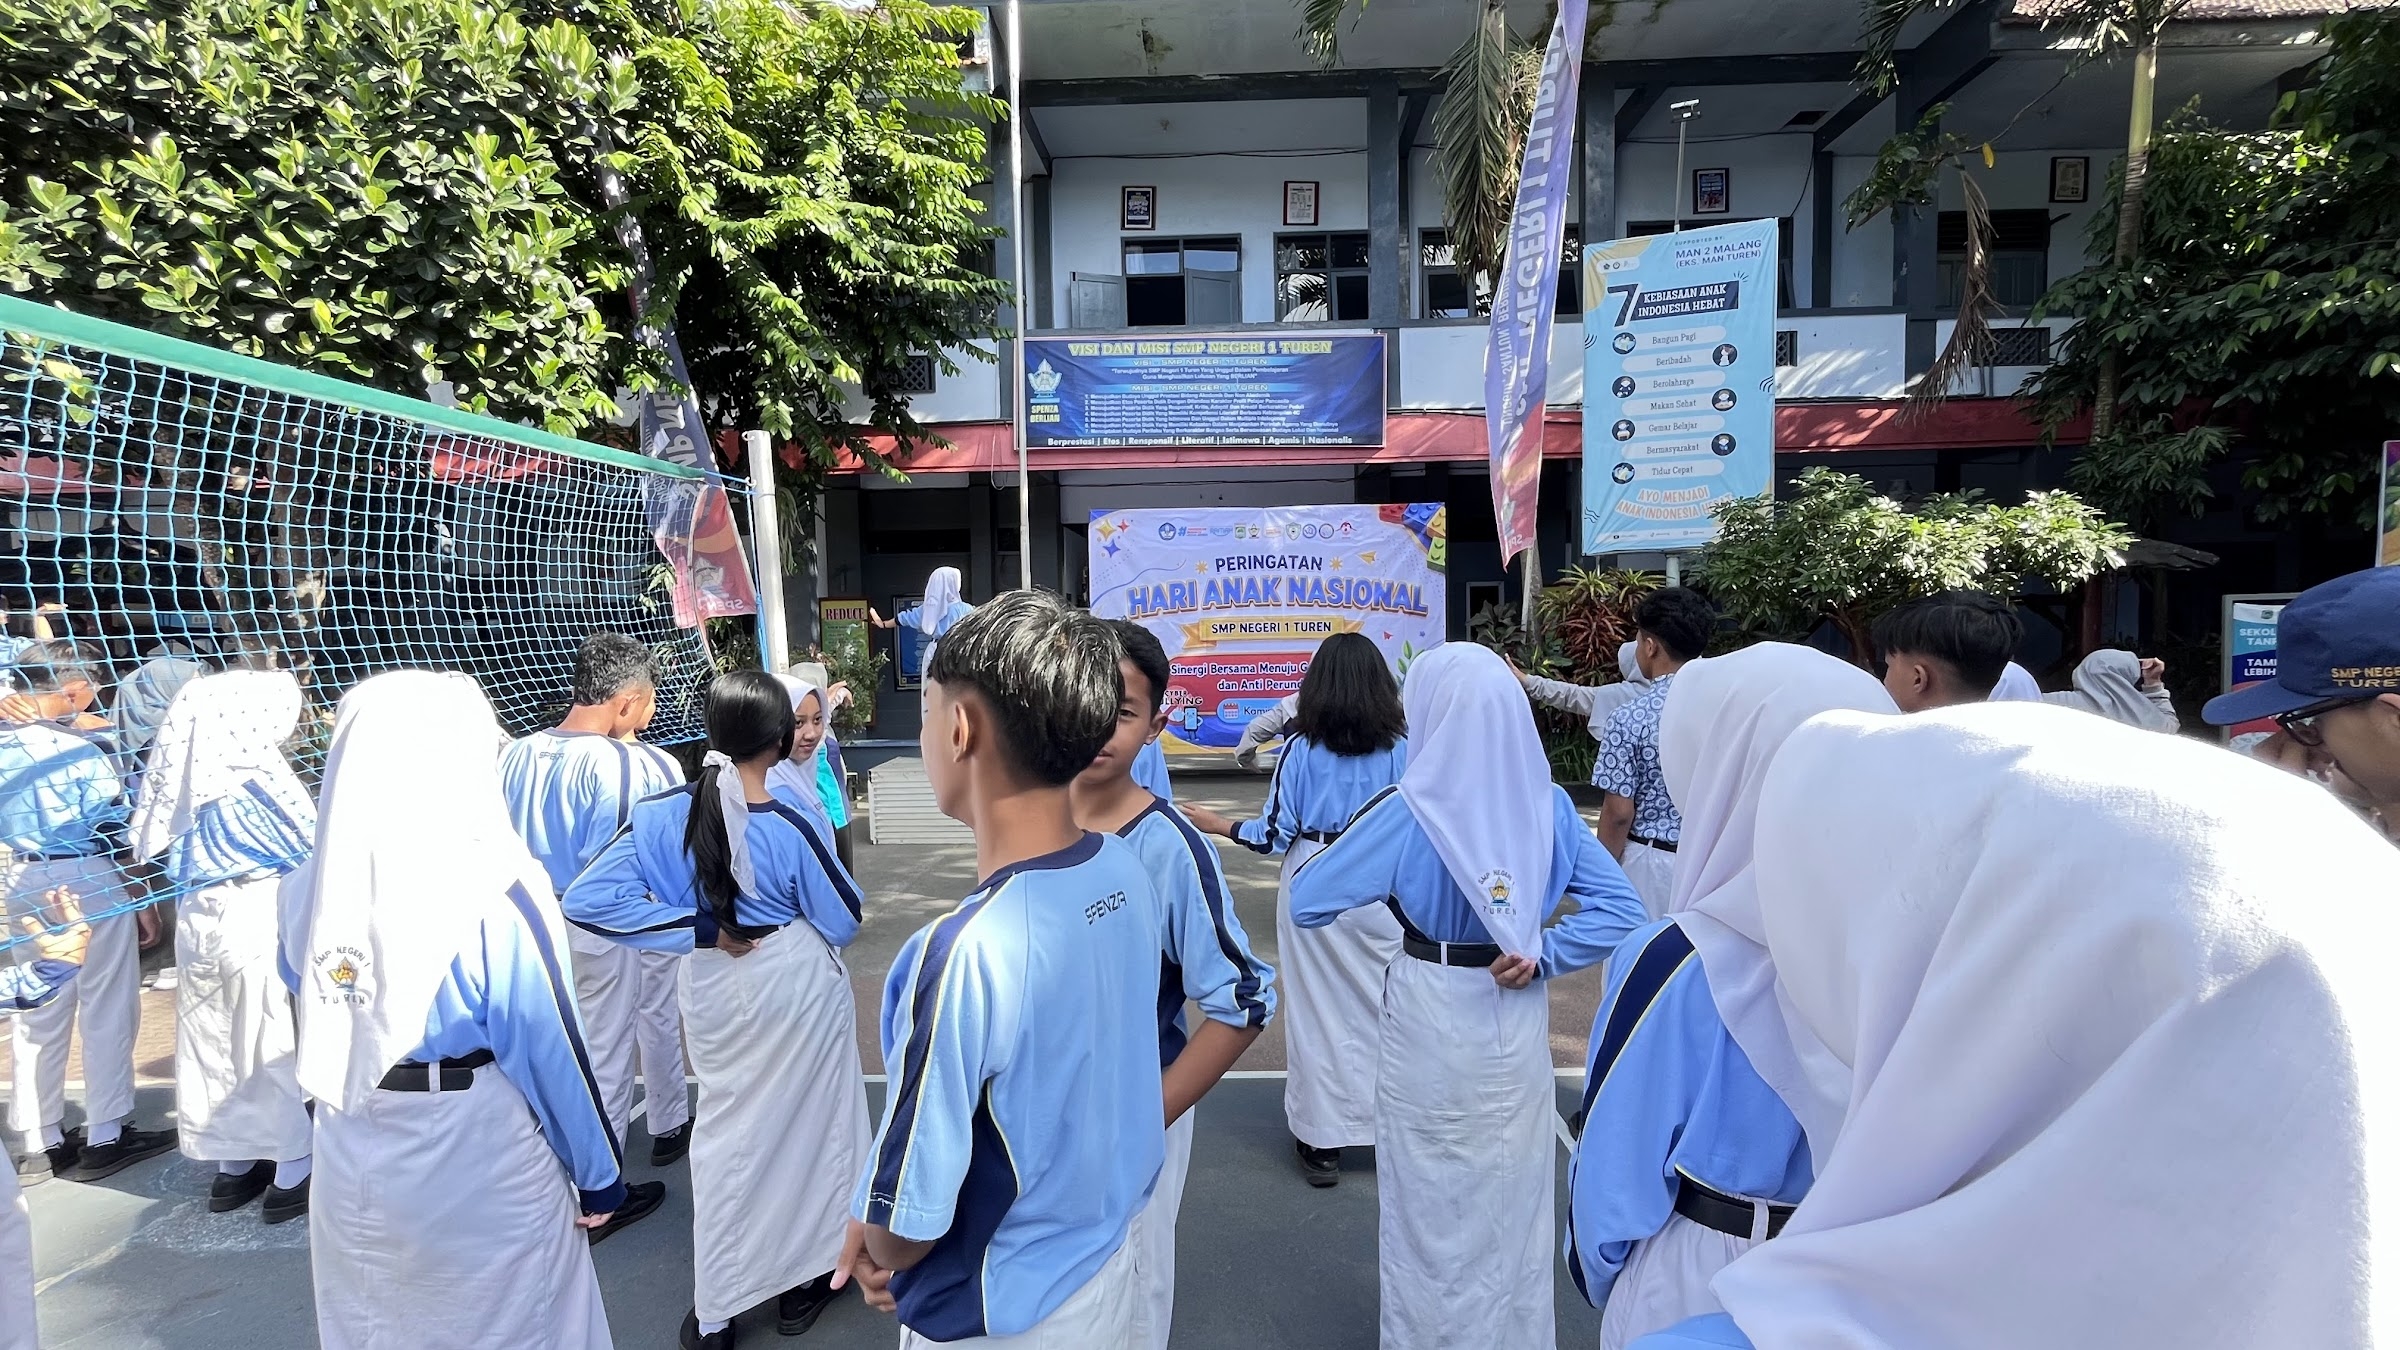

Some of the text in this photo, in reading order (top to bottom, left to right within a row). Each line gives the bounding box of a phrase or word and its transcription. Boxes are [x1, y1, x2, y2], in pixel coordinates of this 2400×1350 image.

[1676, 239, 1762, 259] MAN 2 MALANG
[1676, 249, 1761, 269] (EKS. MAN TUREN)
[1643, 283, 1727, 303] KEBIASAAN ANAK
[1607, 283, 1639, 327] 7
[1638, 298, 1725, 317] INDONESIA HEBAT
[1652, 332, 1696, 345] Bangun Pagi
[1068, 340, 1333, 356] VISI DAN MISI SMP NEGERI 1 TUREN
[1656, 355, 1692, 366] Beribadah
[1653, 377, 1694, 389] Berolahraga
[1031, 405, 1059, 413] SPENZA
[1650, 398, 1697, 409] Makan Sehat
[1030, 414, 1060, 423] BERLIAN
[1649, 421, 1698, 432] Gemar Belajar
[1048, 437, 1094, 447] Berprestasi
[1103, 437, 1120, 445] Etos
[1128, 436, 1174, 446] Rensponsif
[1182, 436, 1215, 445] Literatif
[1223, 436, 1260, 444] Istimewa
[1268, 436, 1300, 446] Agamis
[1308, 436, 1353, 444] Nasionalis
[1646, 443, 1699, 456] Bermasyarakat
[1652, 465, 1693, 476] Tidur Cepat
[1637, 485, 1709, 503] AYO MENJADI
[1616, 501, 1644, 517] ANAK
[1645, 505, 1699, 520] INDONESIA
[1215, 554, 1323, 573] PERINGATAN
[1127, 574, 1428, 619] HARI ANAK NASIONAL
[825, 607, 864, 620] REDUCE
[1211, 621, 1331, 634] SMP NEGERI 1 TUREN
[2239, 628, 2276, 636] SEKOL
[1170, 663, 1207, 677] Sinergi
[1210, 664, 1256, 675] Bersama
[1259, 662, 1298, 676] Menuju
[2244, 668, 2276, 676] LEBIH
[2331, 666, 2400, 678] SMP NEGE
[1217, 680, 1237, 691] dan
[1240, 679, 1263, 691] Anti
[2332, 679, 2398, 688] TURE
[1084, 890, 1127, 925] SPENZA
[1483, 905, 1517, 915] TUREN
[314, 950, 331, 967] SMP
[336, 946, 365, 961] NEGERI
[320, 993, 365, 1004] TUREN
